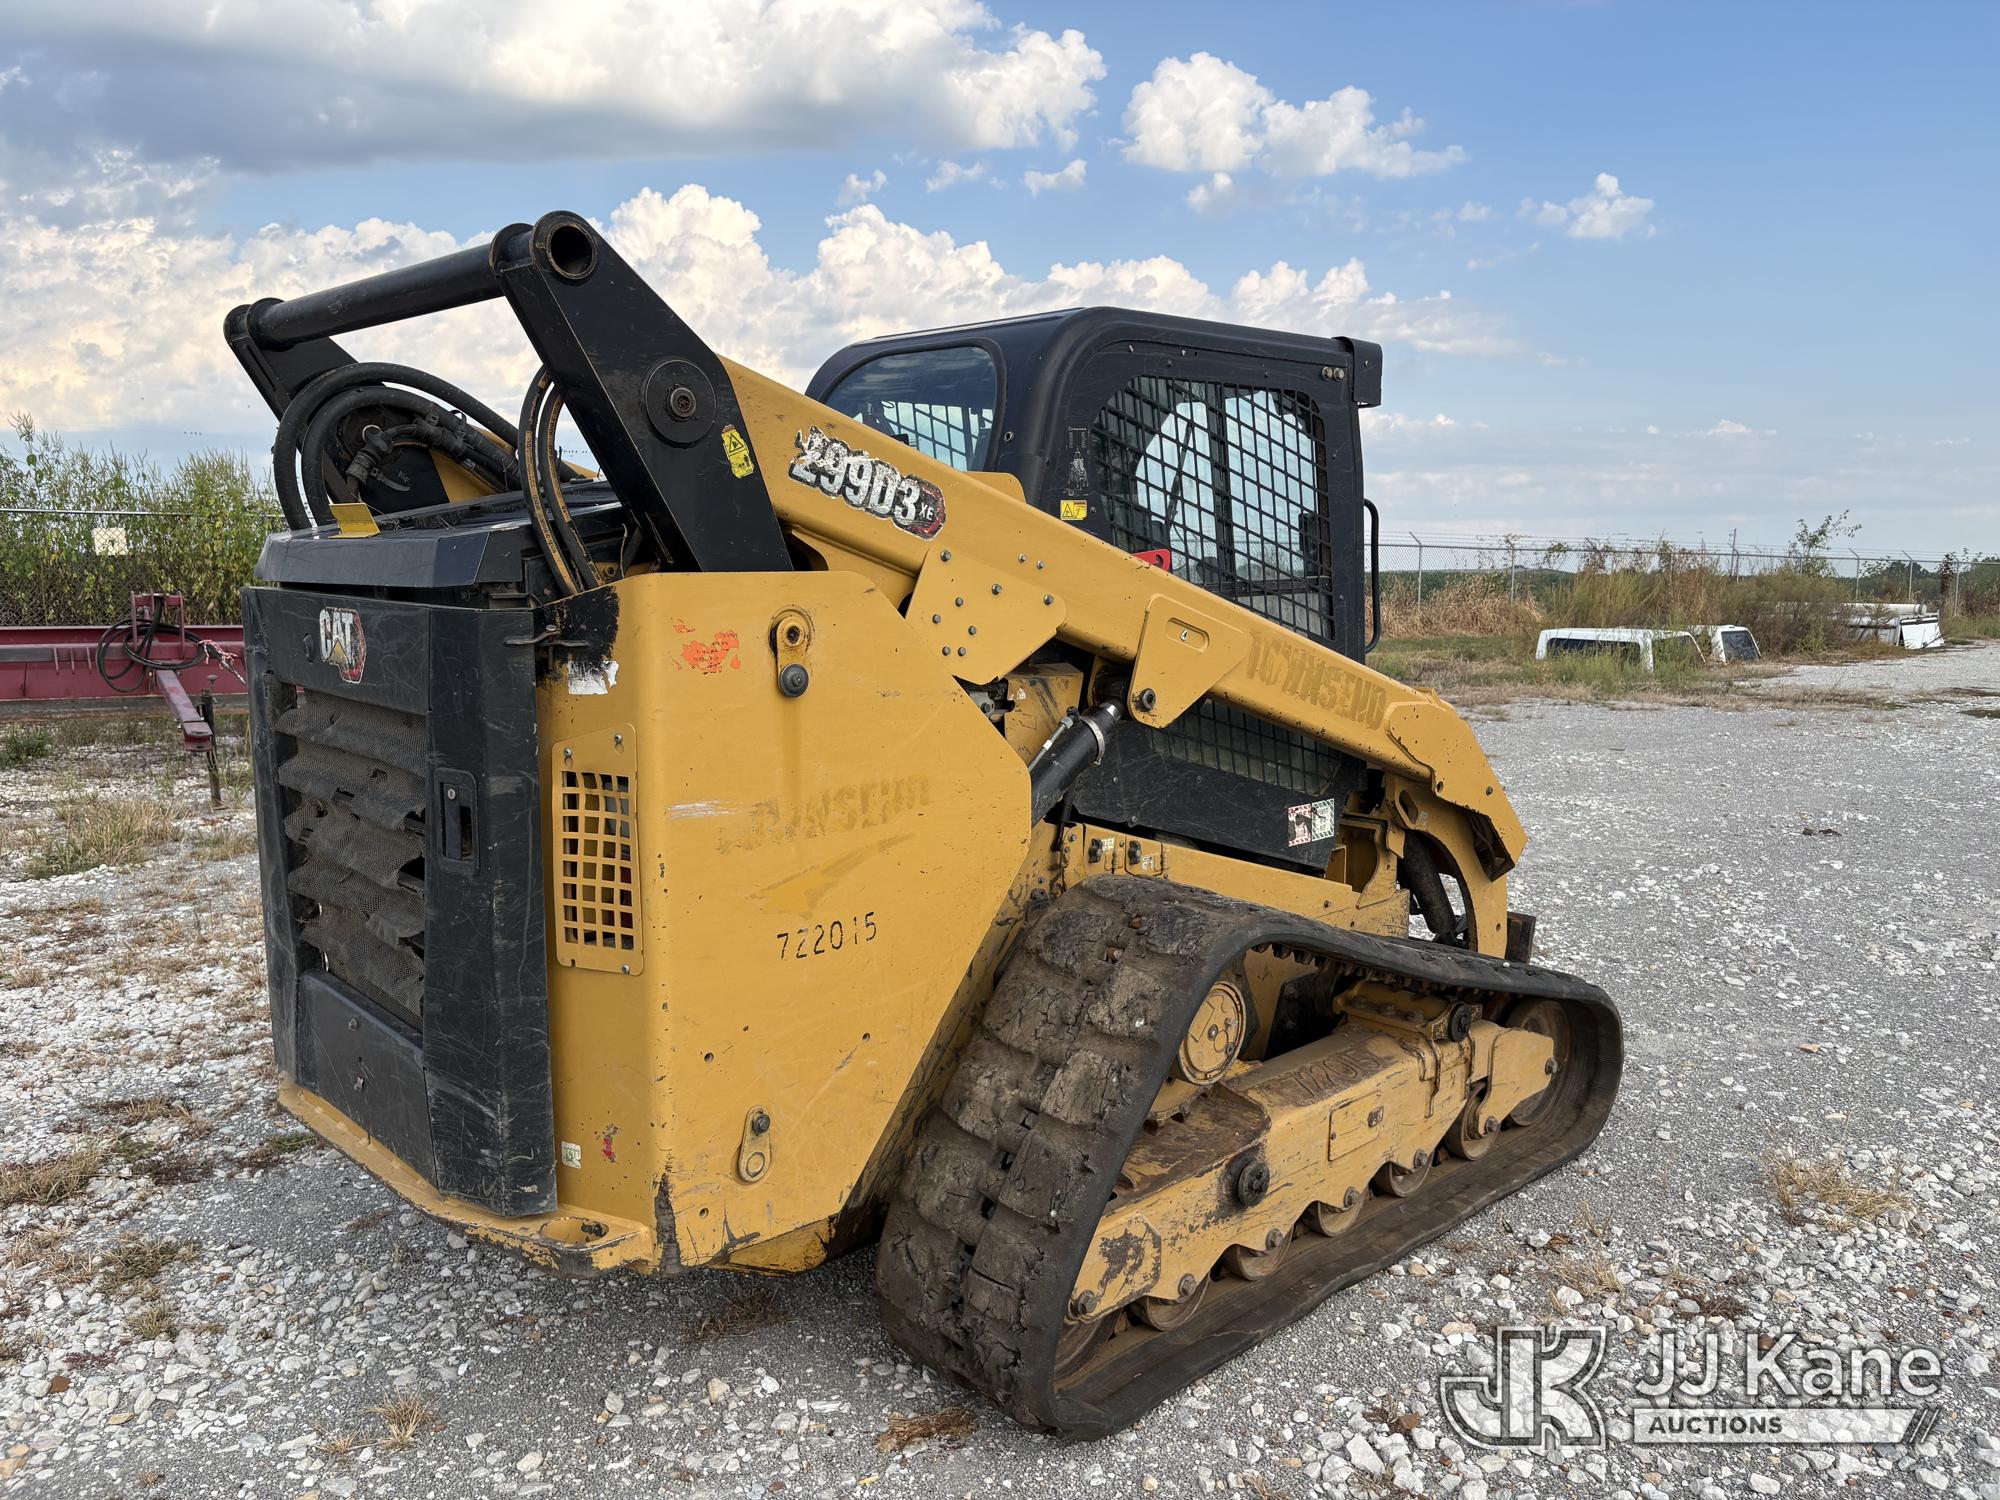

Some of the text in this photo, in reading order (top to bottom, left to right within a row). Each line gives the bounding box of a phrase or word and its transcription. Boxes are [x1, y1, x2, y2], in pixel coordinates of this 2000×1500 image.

[918, 502, 935, 521] XE
[318, 608, 354, 666] CAT
[777, 911, 877, 960] 722015
